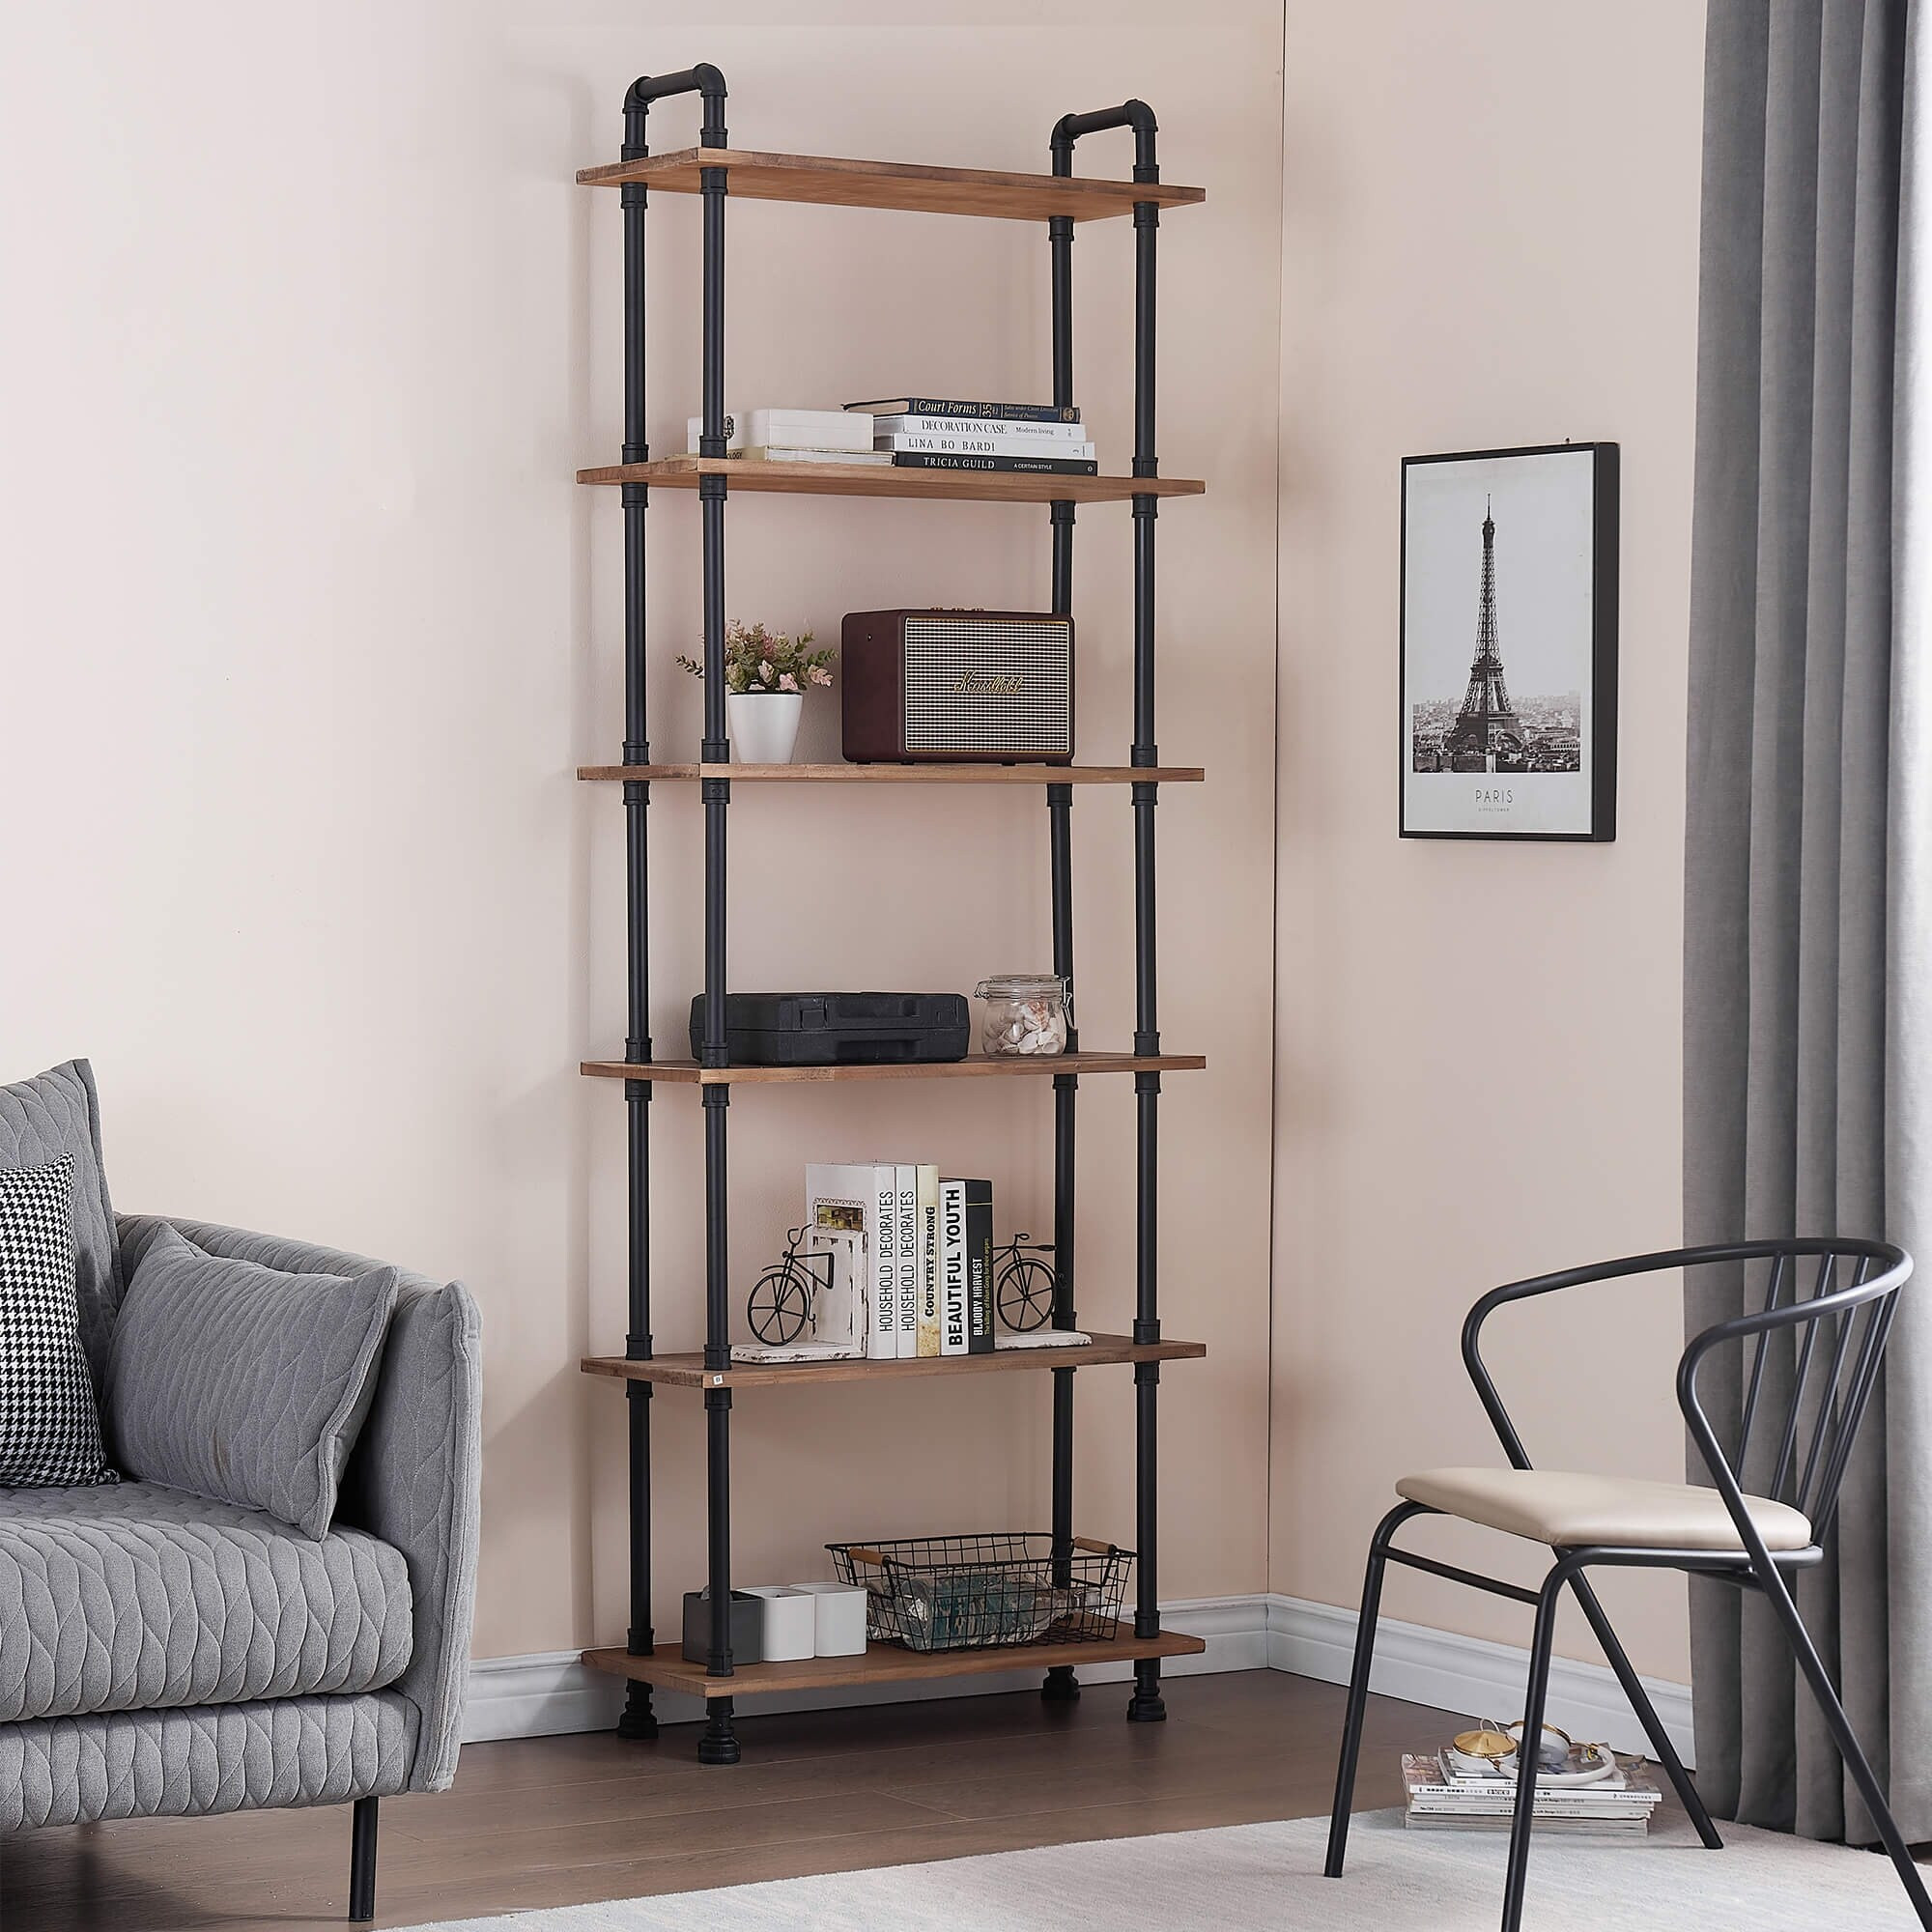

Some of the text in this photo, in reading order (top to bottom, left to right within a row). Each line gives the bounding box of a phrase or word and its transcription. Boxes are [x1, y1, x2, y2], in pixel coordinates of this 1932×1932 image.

[918, 400, 977, 414] Court Forms
[922, 419, 982, 433] DECORATION
[984, 424, 1008, 435] CASE
[908, 438, 996, 452] LINA BO BARDI
[923, 456, 959, 468] TRICIA
[962, 459, 996, 469] GUILD
[1475, 788, 1514, 804] PARIS
[879, 1190, 894, 1332] HOUSEHOLD DECORATES
[900, 1190, 915, 1331] HOUSEHOLD DECORATES
[924, 1207, 936, 1317] COUNTRY STRONG
[946, 1188, 963, 1346] BEAUTIFUL YOUTH
[972, 1257, 983, 1336] BLOODY HARVEST
